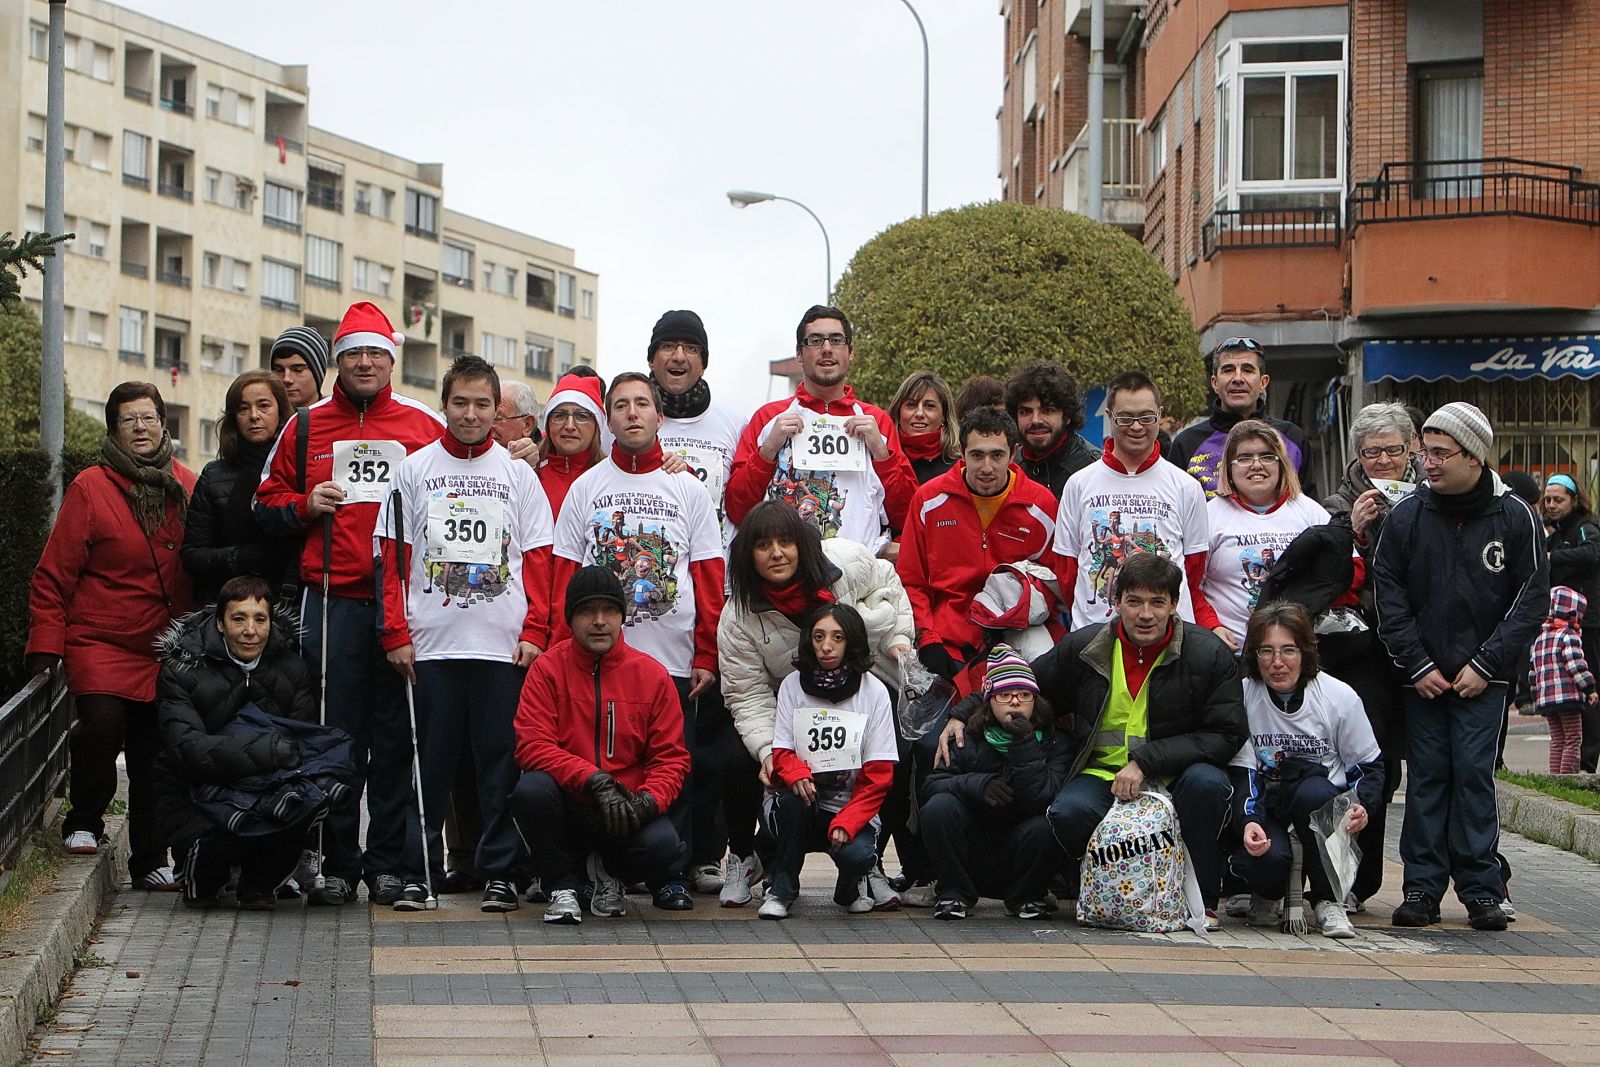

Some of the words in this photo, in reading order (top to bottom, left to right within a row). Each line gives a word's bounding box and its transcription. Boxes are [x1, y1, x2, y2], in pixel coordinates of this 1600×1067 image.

[1469, 347, 1535, 371] La
[808, 434, 849, 455] 360
[348, 460, 390, 483] 352
[424, 475, 447, 492] XXIX
[447, 480, 465, 488] SAN
[455, 488, 509, 500] SALMANTINA
[636, 492, 663, 500] POPULAR
[1089, 494, 1111, 508] XXIX
[592, 494, 614, 511] XXIX
[614, 498, 631, 506] SAN
[633, 497, 679, 512] SILVESTRE
[1111, 499, 1128, 507] SAN
[1129, 499, 1172, 512] SILVESTRE
[621, 505, 679, 519] SALMANTINA
[1118, 506, 1169, 519] SALMANTINA
[444, 518, 487, 543] 350
[1235, 533, 1260, 547] XXIX
[807, 726, 847, 752] 359
[1253, 734, 1274, 747] XXIX
[1274, 739, 1290, 747] SAN
[1089, 830, 1175, 868] MORGAN
